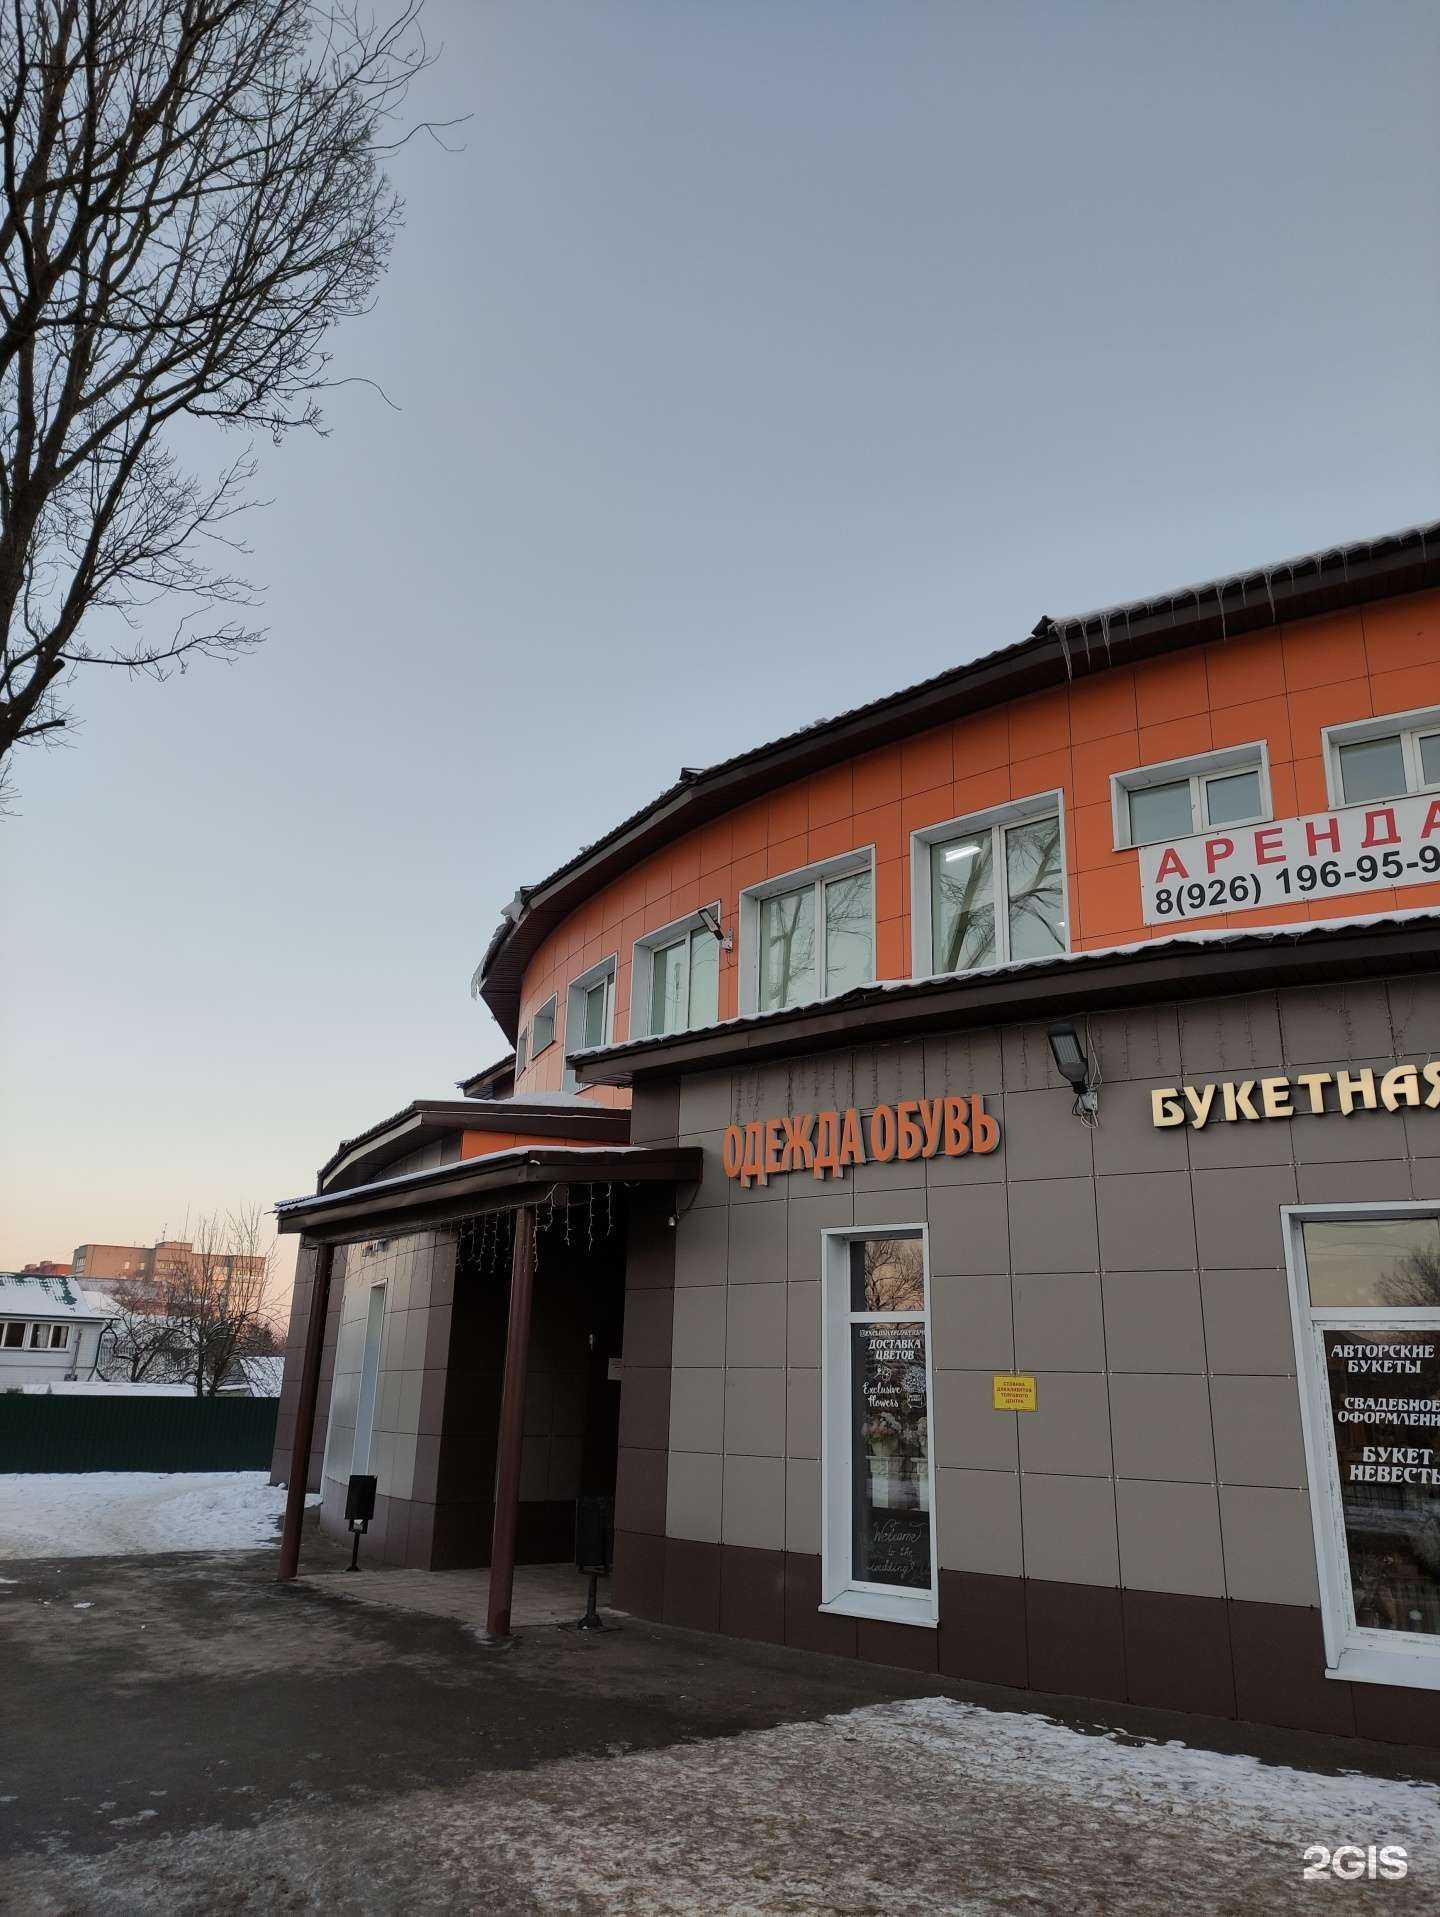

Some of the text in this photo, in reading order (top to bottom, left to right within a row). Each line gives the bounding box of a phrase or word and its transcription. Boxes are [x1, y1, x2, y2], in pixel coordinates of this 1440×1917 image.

[1155, 800, 1440, 883] АРЕНДА
[1155, 873, 1262, 917] 8(926)
[722, 1094, 1000, 1188] ОДЕЖДА ОБУВЬ
[868, 1339, 921, 1350] ДОСТАВКА
[1331, 1344, 1435, 1359] АВТОРСКИЕ
[875, 1350, 915, 1361] ЦВЕТОВ
[1347, 1360, 1422, 1374] БУКЕТЫ
[862, 1381, 902, 1395] Exclusive
[1344, 1397, 1440, 1412] СВАДЕБНОЕ
[1362, 1446, 1434, 1465] БУКЕТ
